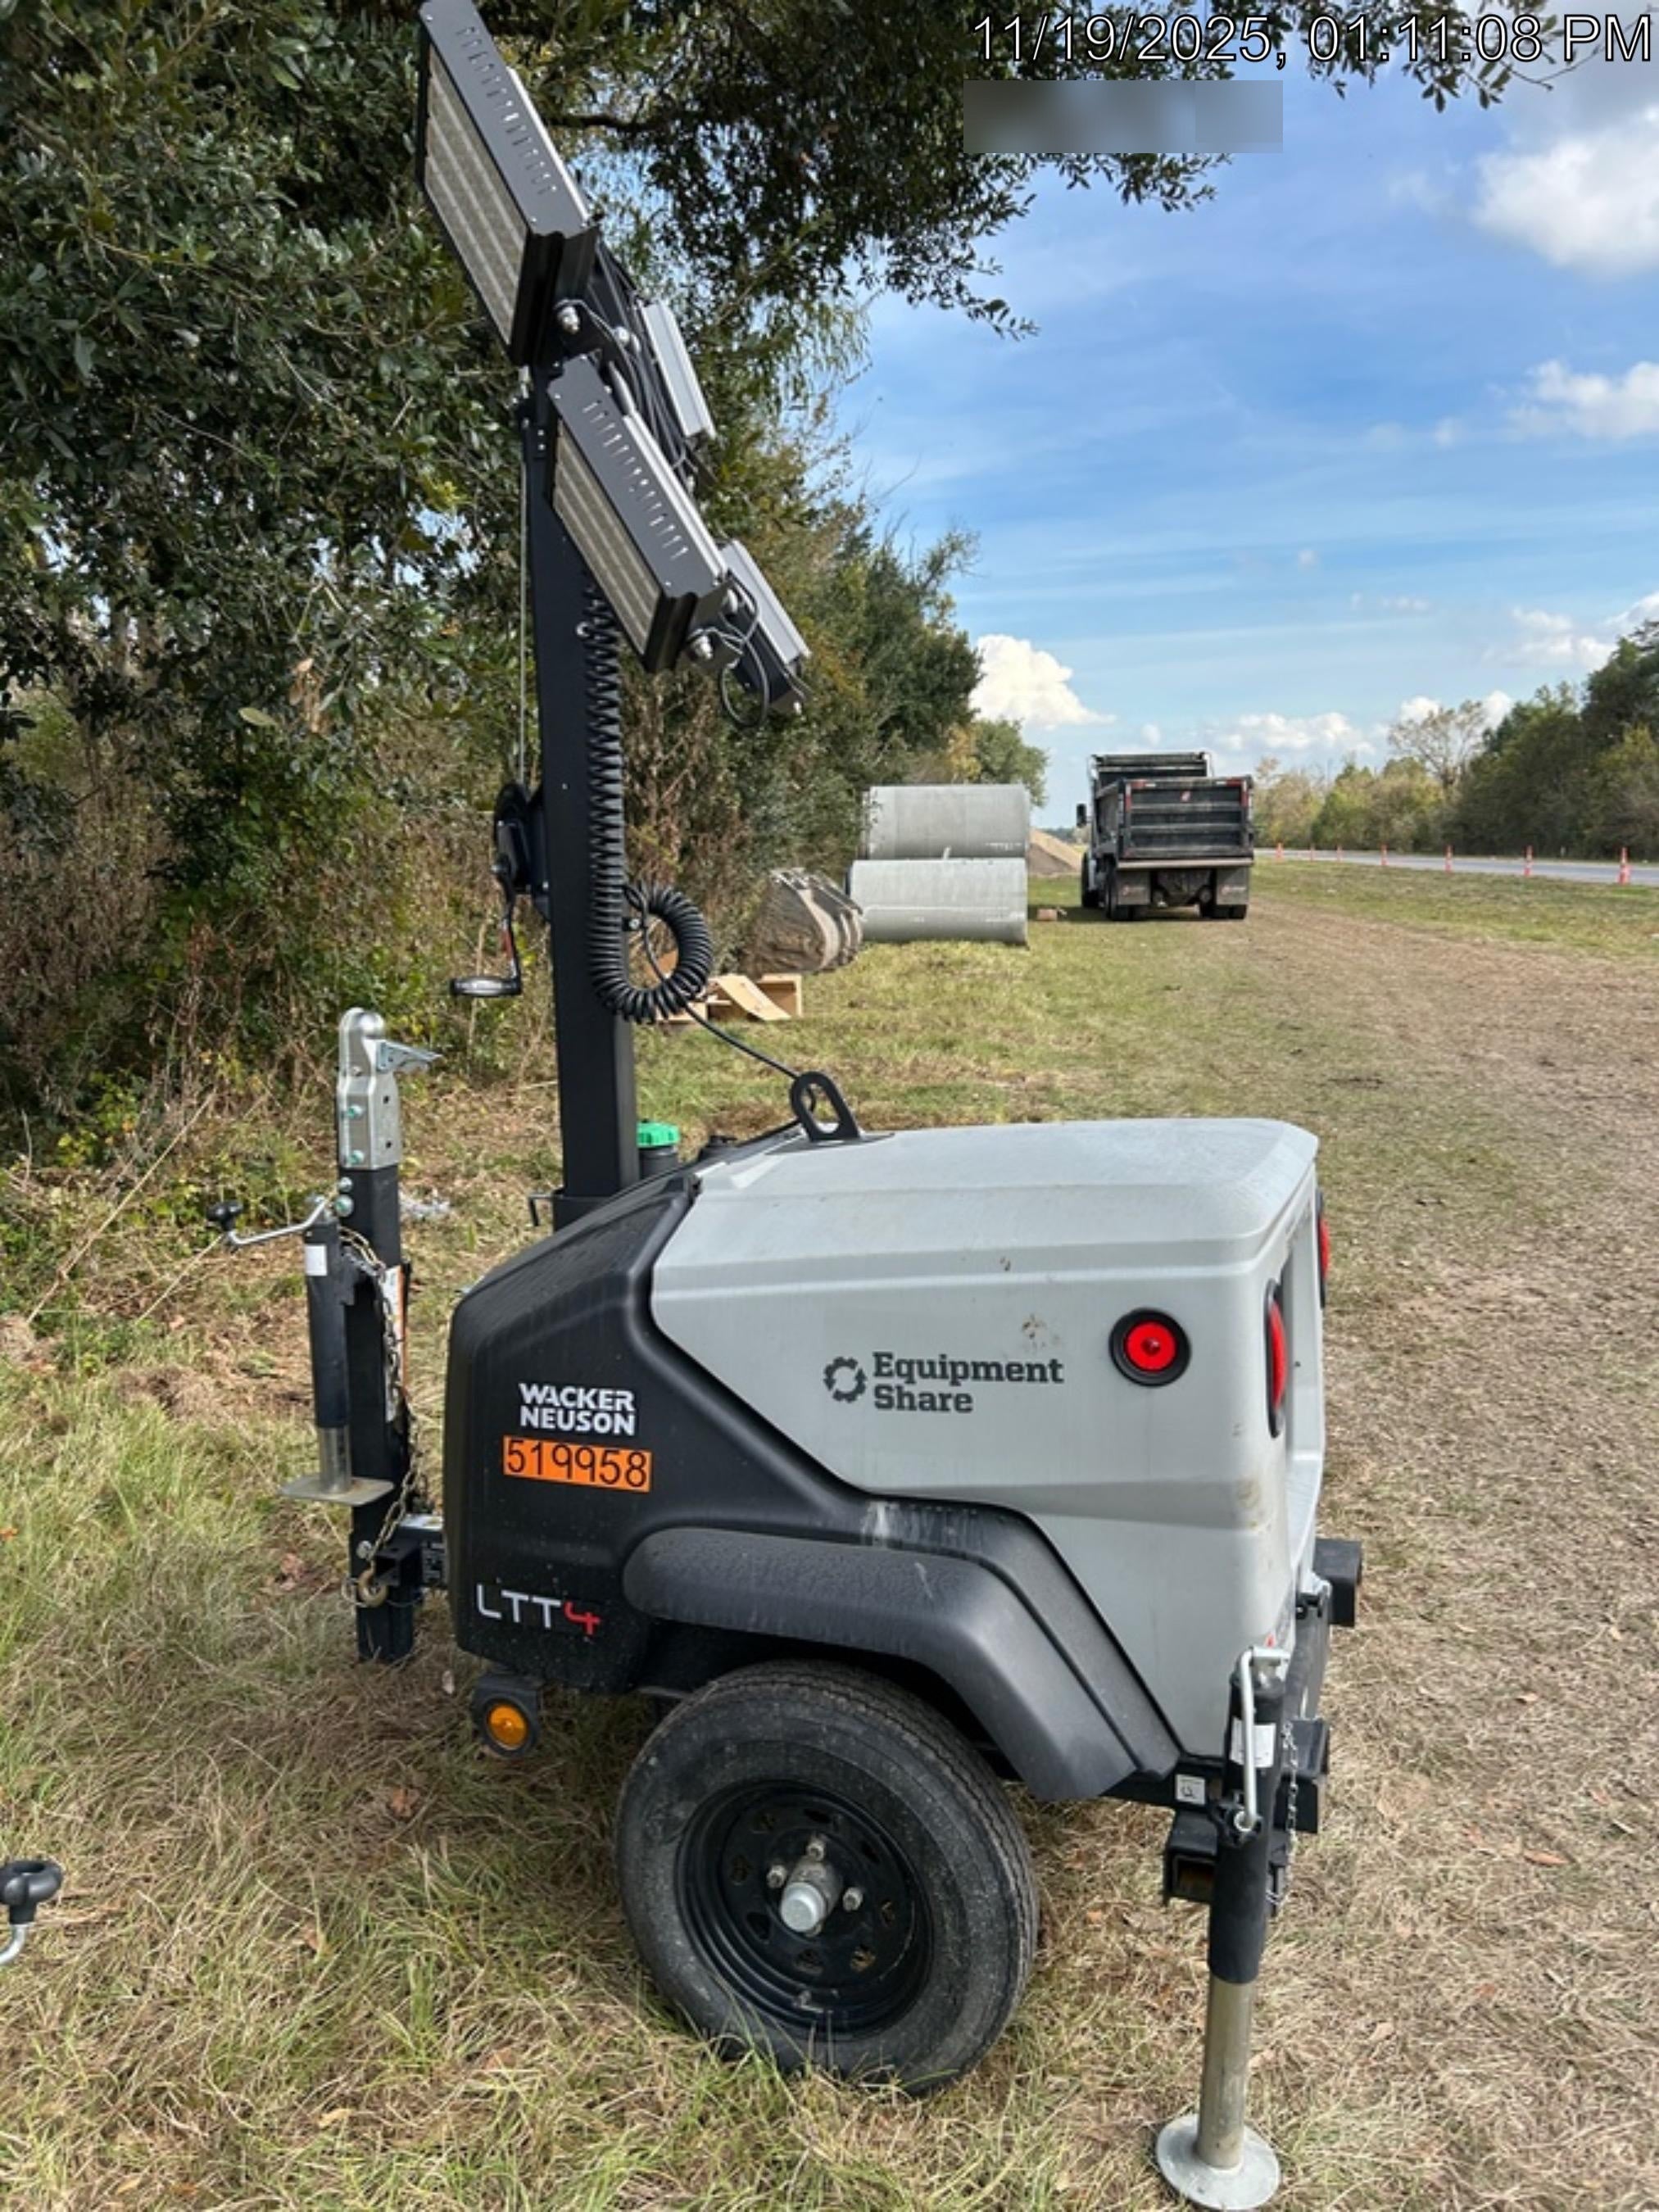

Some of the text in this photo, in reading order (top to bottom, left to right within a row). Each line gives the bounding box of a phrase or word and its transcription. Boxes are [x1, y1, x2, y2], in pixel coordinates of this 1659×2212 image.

[873, 1352, 1063, 1385] Equipment
[519, 1382, 635, 1412] WACKER
[873, 1385, 973, 1413] Share
[519, 1407, 635, 1435] NEUSON
[507, 1439, 647, 1488] 519958
[476, 1584, 601, 1635] LTT4
